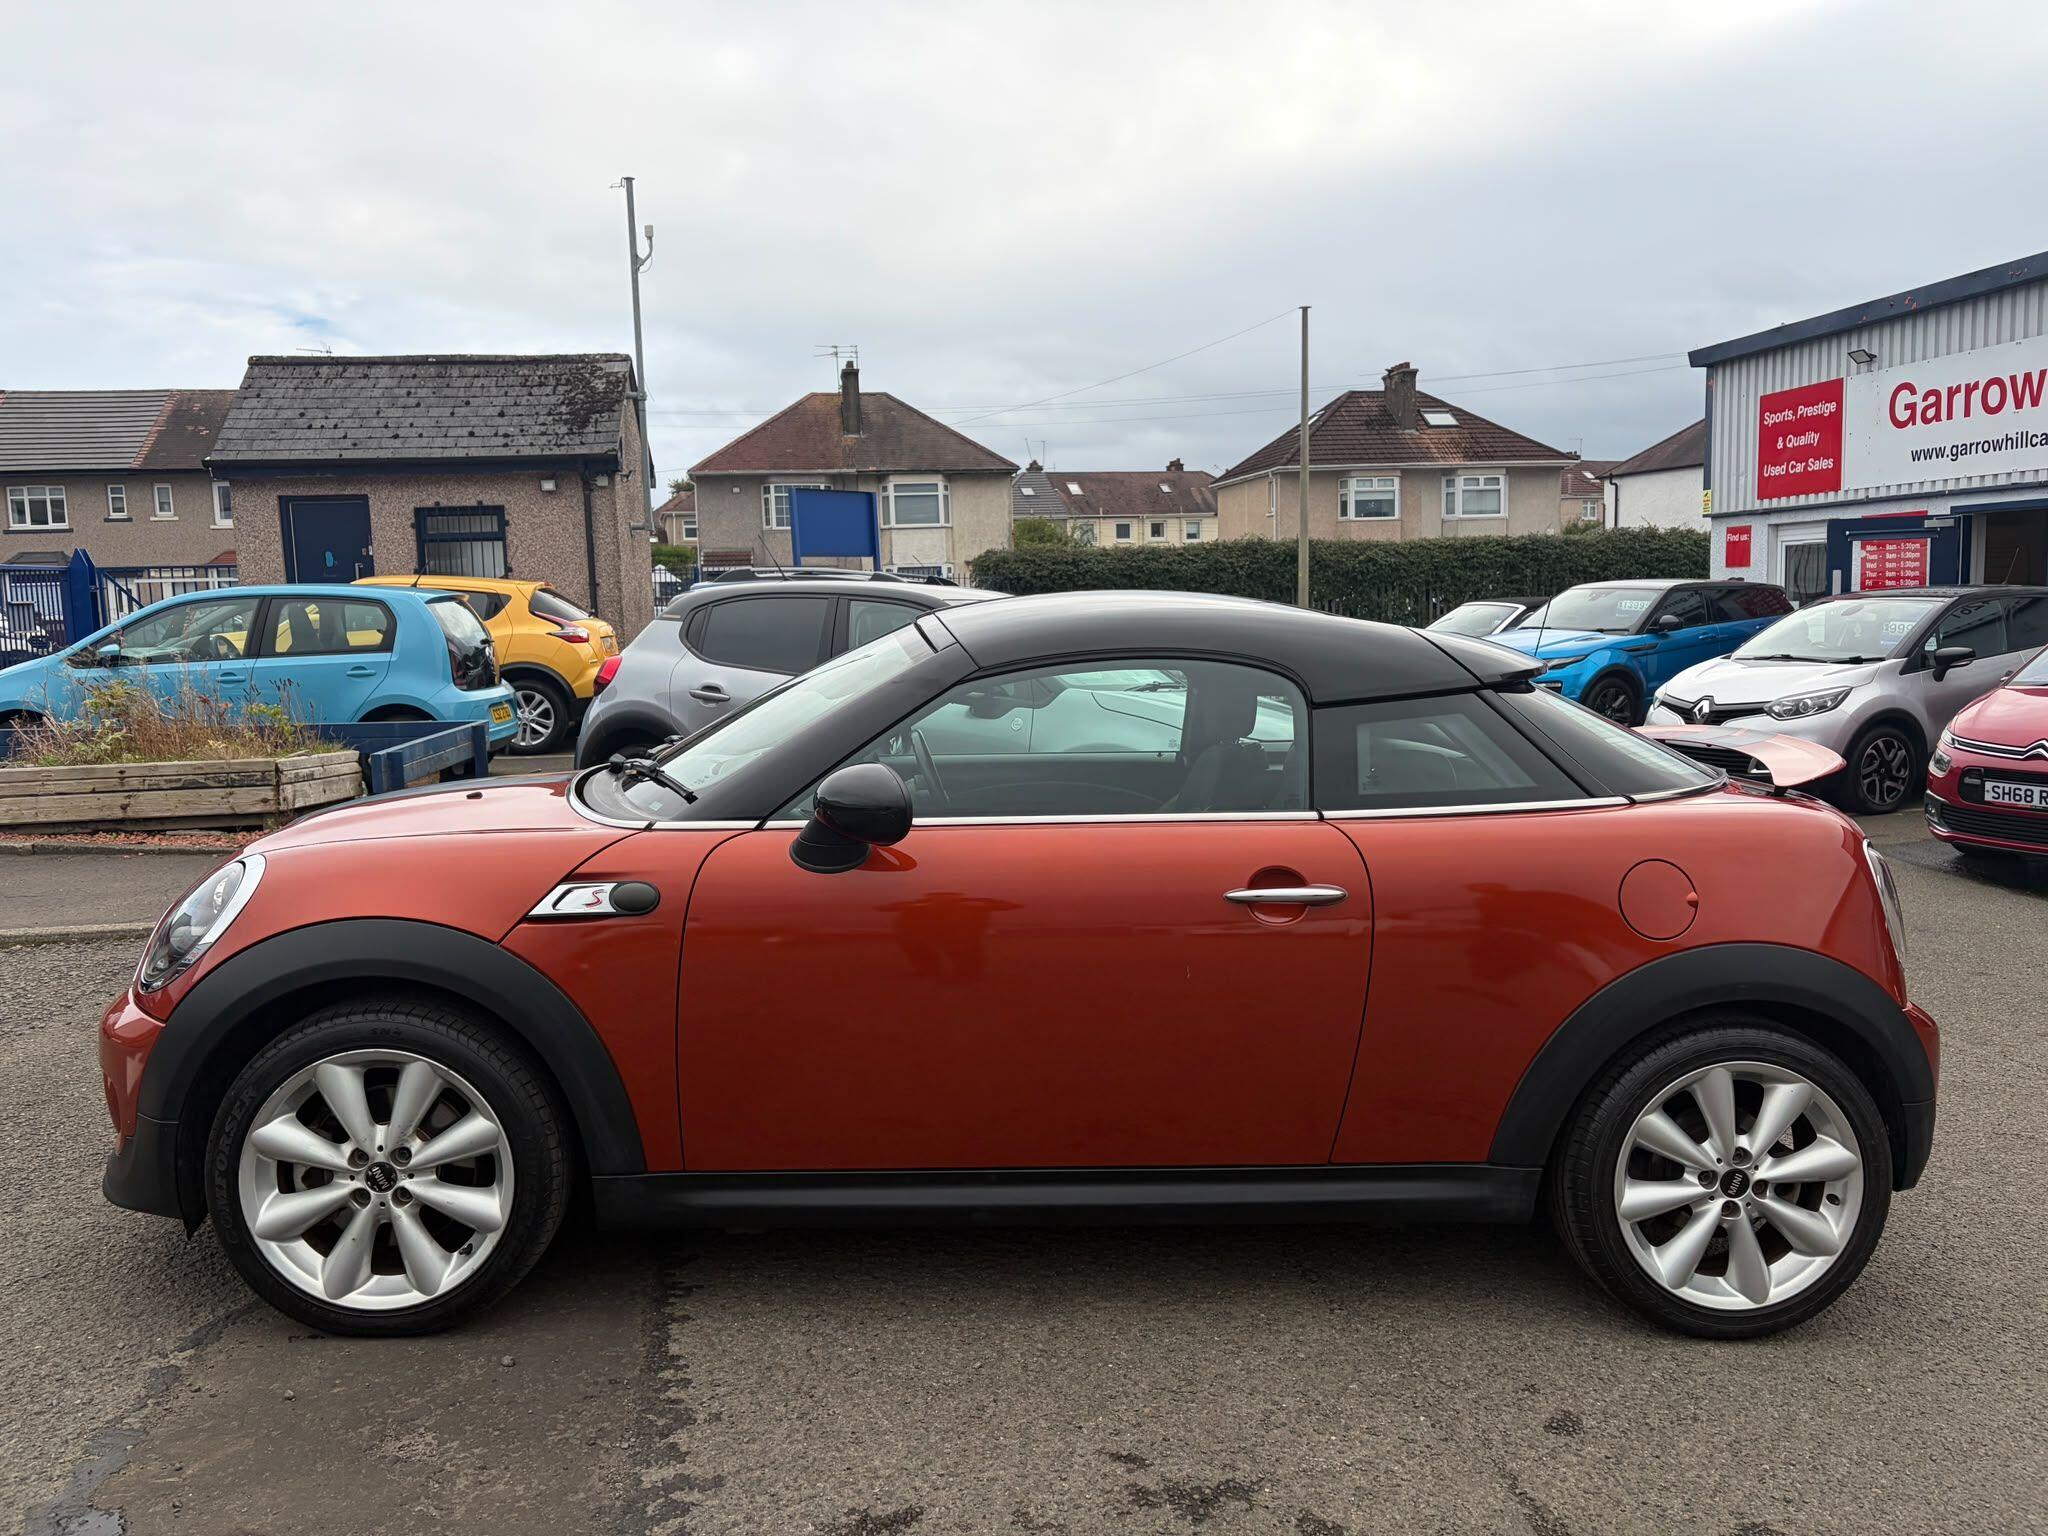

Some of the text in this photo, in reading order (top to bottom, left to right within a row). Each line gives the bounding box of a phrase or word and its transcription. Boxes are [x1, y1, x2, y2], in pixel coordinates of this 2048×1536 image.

[1888, 369, 2048, 429] Garrow
[1763, 400, 1837, 427] Sports, Prestige
[1777, 431, 1820, 450] & Quality
[1911, 430, 2048, 462] www.garrowhillca
[1763, 457, 1834, 477] Used Car Sales
[1727, 533, 1740, 542] Find
[1991, 785, 2048, 805] SH68 R
[1727, 1173, 1743, 1196] MINI
